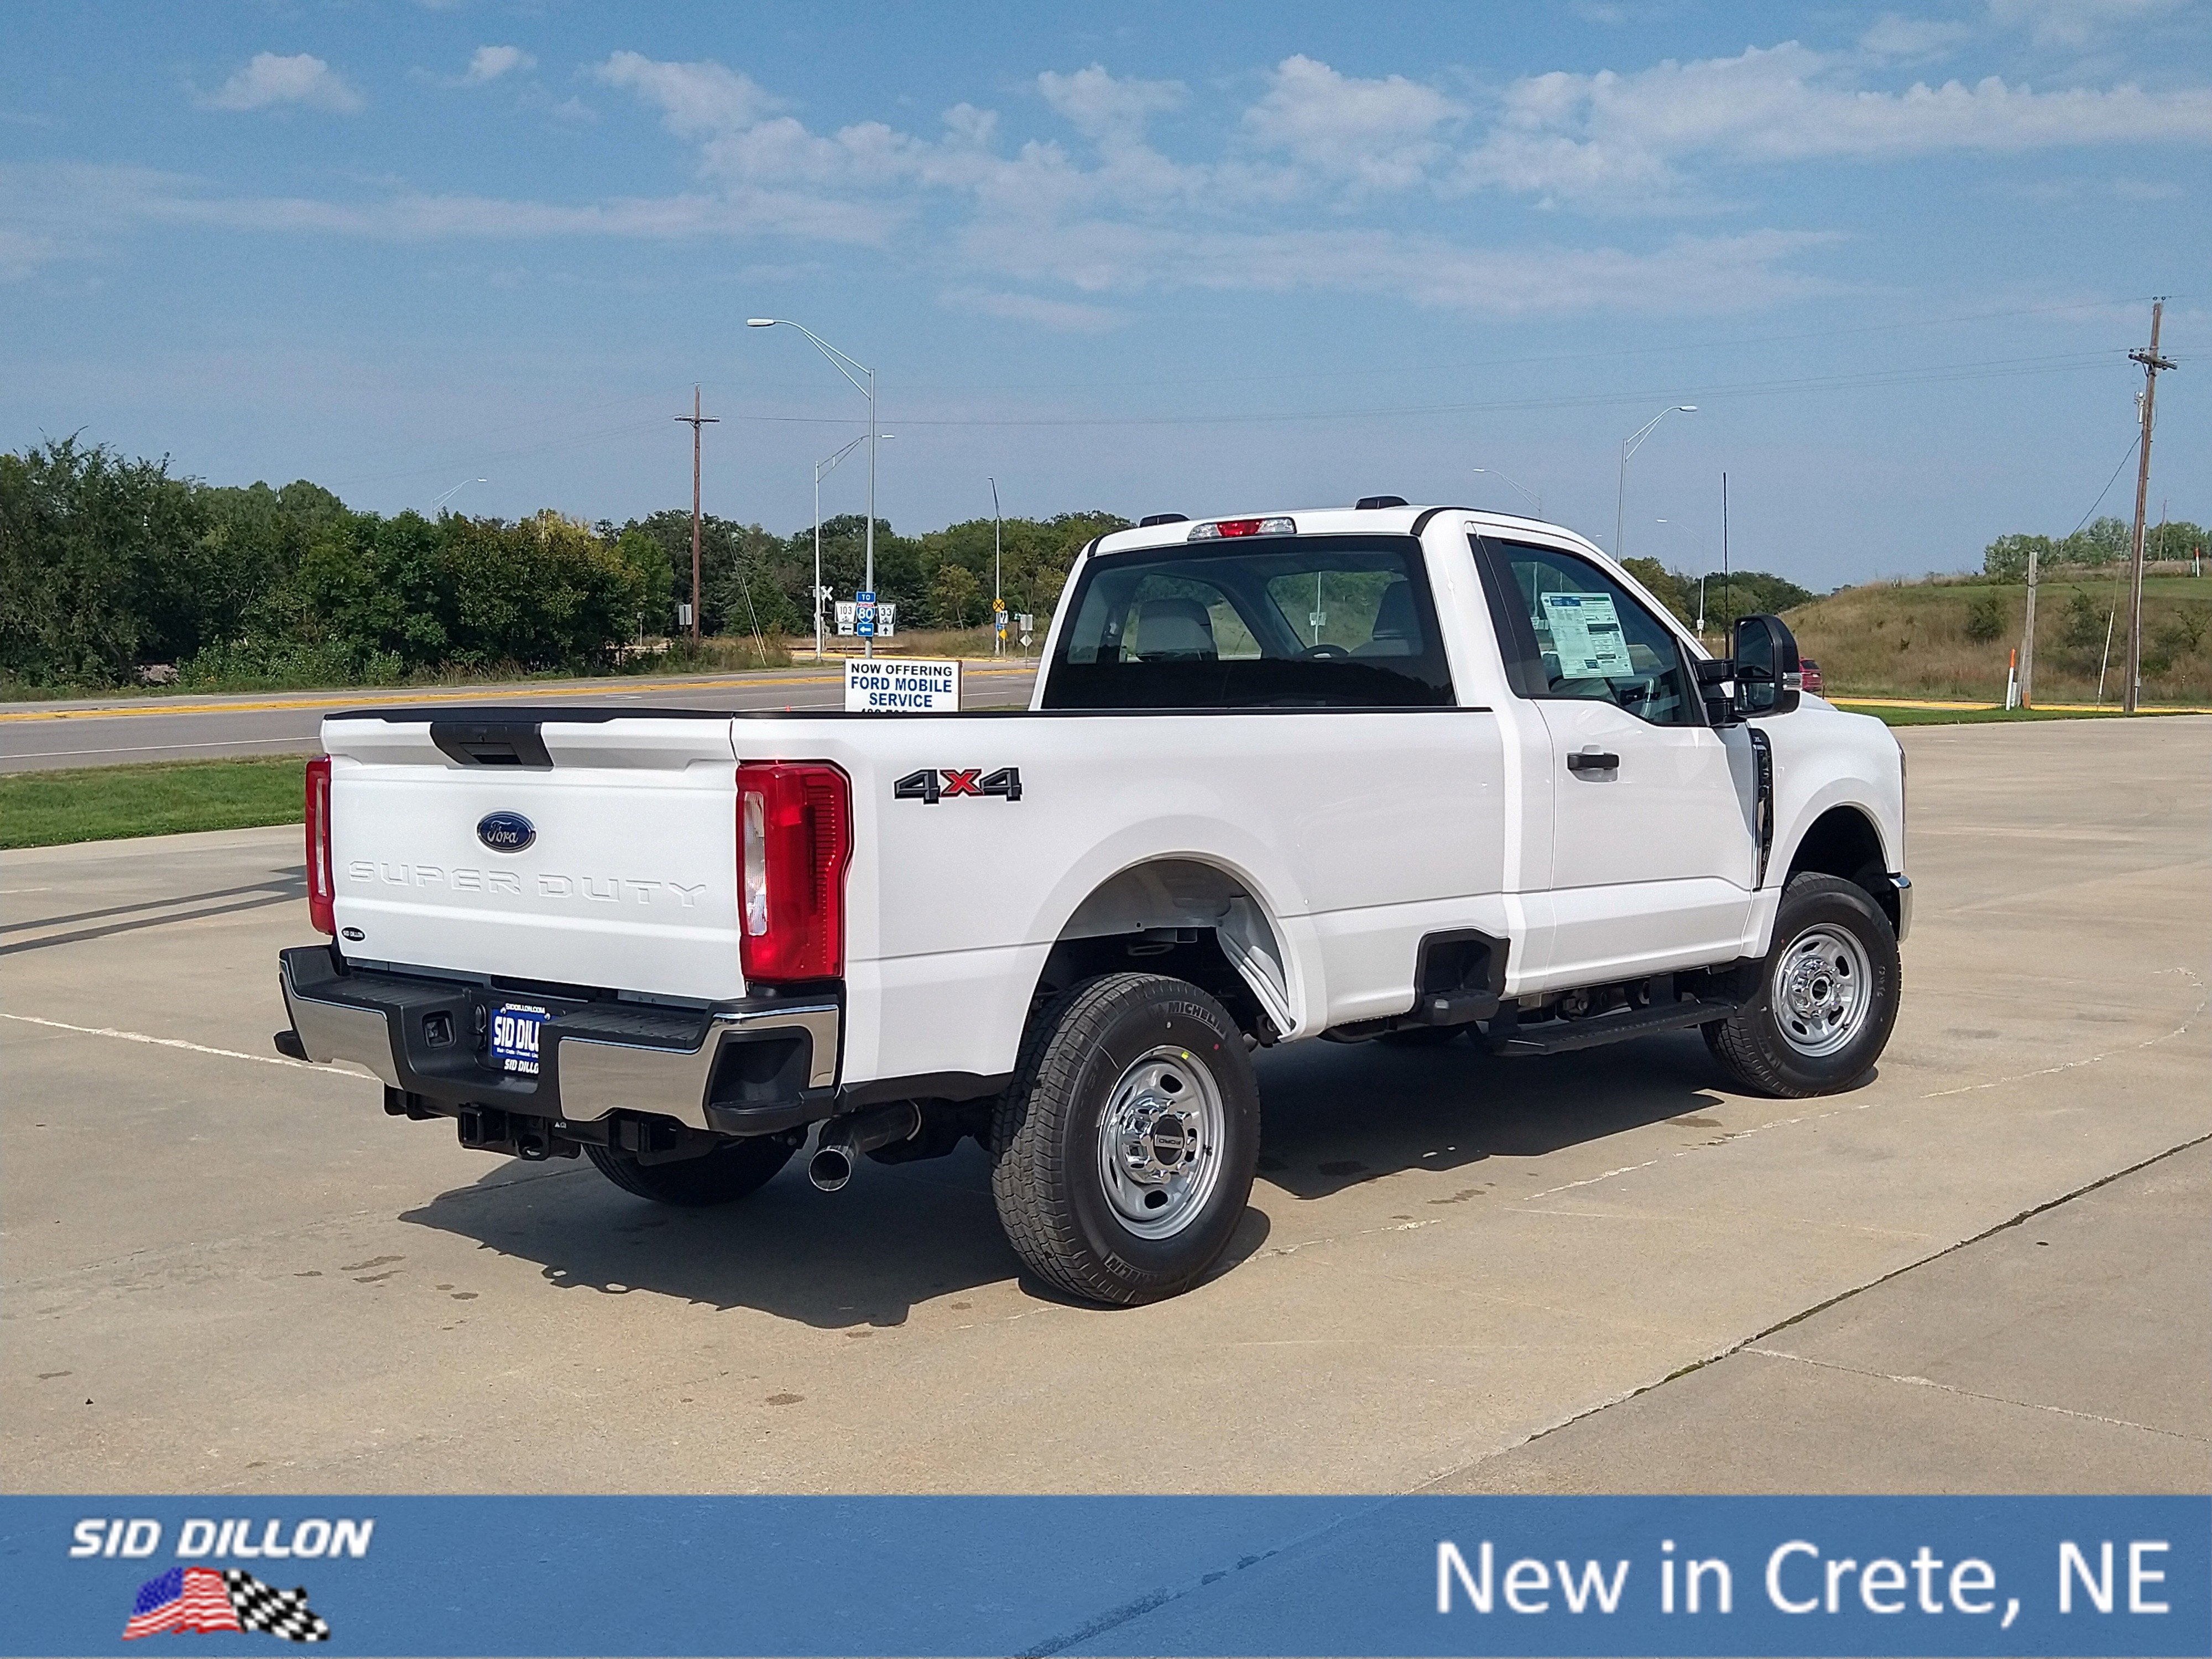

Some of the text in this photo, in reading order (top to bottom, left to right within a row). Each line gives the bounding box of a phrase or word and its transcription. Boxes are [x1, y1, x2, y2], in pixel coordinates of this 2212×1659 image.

[840, 606, 852, 614] 103
[858, 607, 873, 619] 80
[881, 608, 891, 616] 33
[851, 664, 952, 676] NOW OFFERING
[851, 676, 952, 692] FORD MOBILE
[869, 692, 932, 708] SERVICE
[487, 820, 519, 843] Ford
[349, 860, 706, 907] SUPER DUTY
[494, 1016, 515, 1048] SID
[504, 1058, 518, 1071] SID
